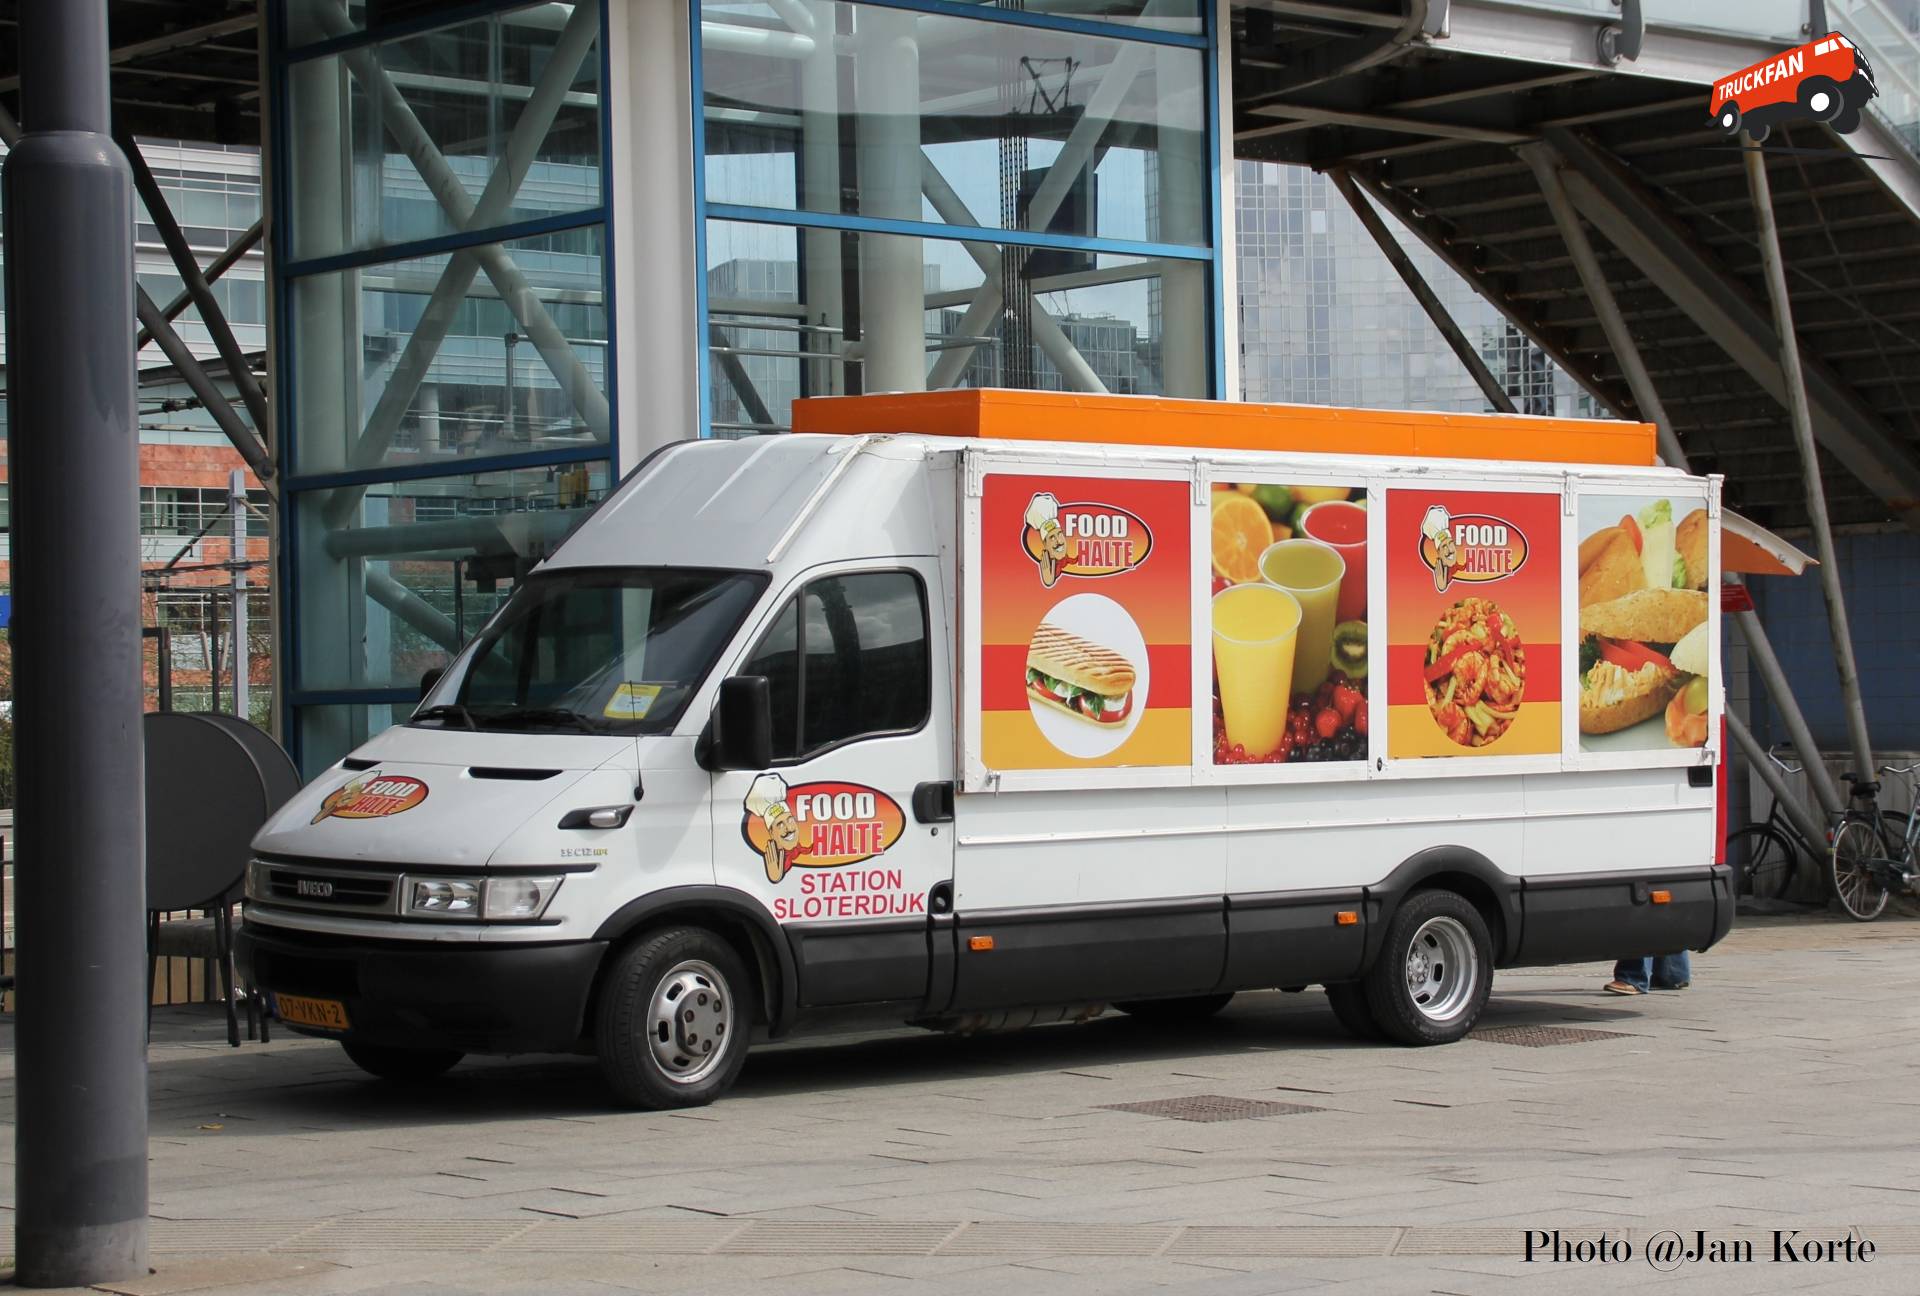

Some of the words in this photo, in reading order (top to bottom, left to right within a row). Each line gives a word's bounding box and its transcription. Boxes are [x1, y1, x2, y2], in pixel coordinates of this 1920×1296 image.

[1064, 513, 1128, 538] FOOD
[1455, 524, 1508, 546] FOOD
[1077, 540, 1134, 568] HALTE
[1465, 548, 1512, 573] HALTE
[362, 780, 419, 797] FOOD
[351, 795, 406, 816] HALTE
[796, 792, 876, 822] FOOD
[812, 822, 884, 857] HALTE
[297, 880, 333, 896] IVECO
[800, 869, 902, 895] STATION
[774, 892, 925, 919] SLOTERDIJK
